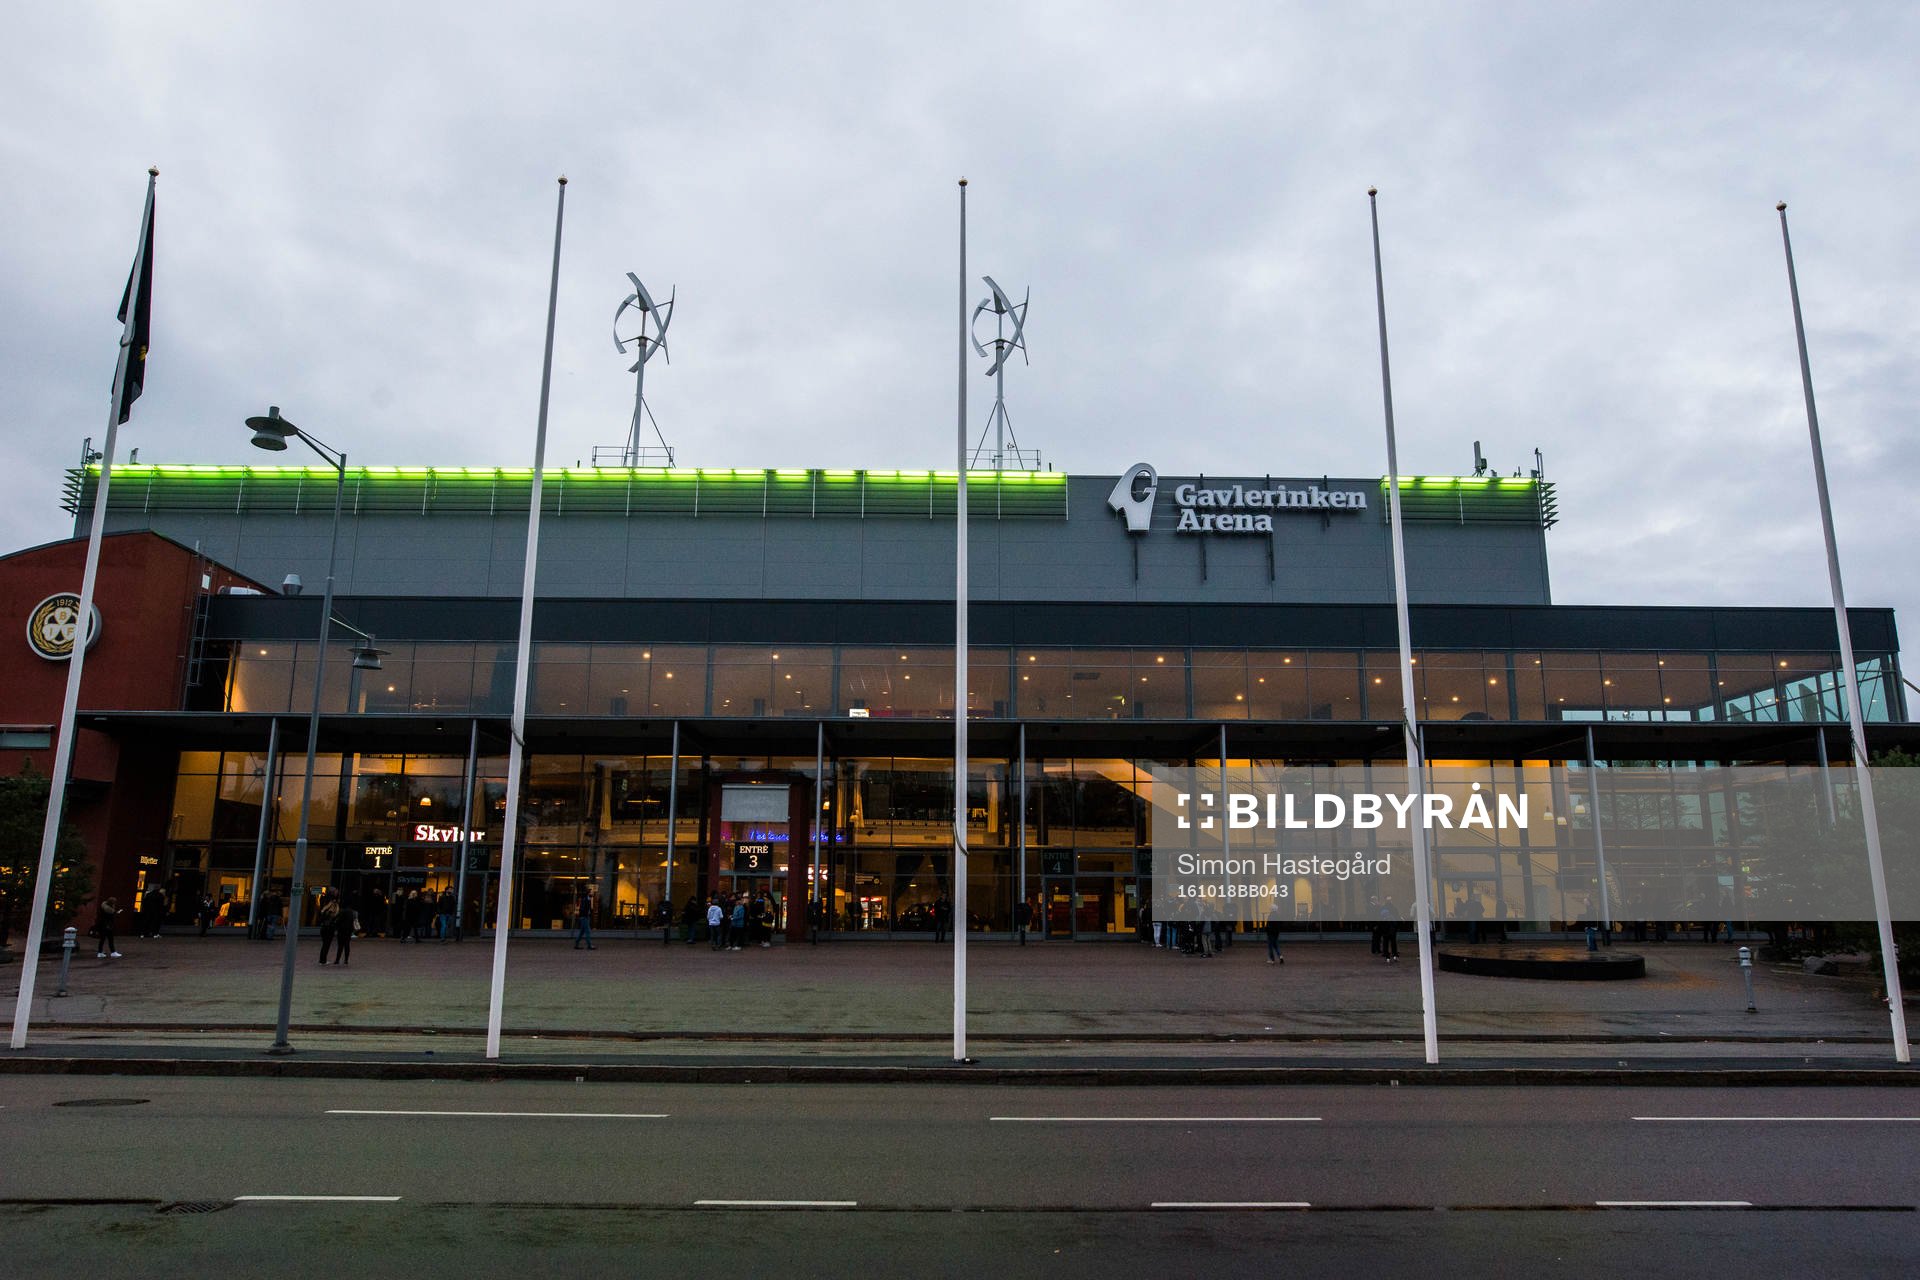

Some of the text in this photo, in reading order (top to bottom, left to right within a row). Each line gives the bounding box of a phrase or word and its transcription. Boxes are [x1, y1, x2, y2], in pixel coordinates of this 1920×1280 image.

[1175, 484, 1368, 510] Gavlerinken
[1177, 509, 1273, 533] Arena
[365, 844, 393, 855] ENTRÉ
[739, 845, 769, 854] ENTRÉ
[374, 856, 381, 869] 1
[748, 855, 758, 869] 3
